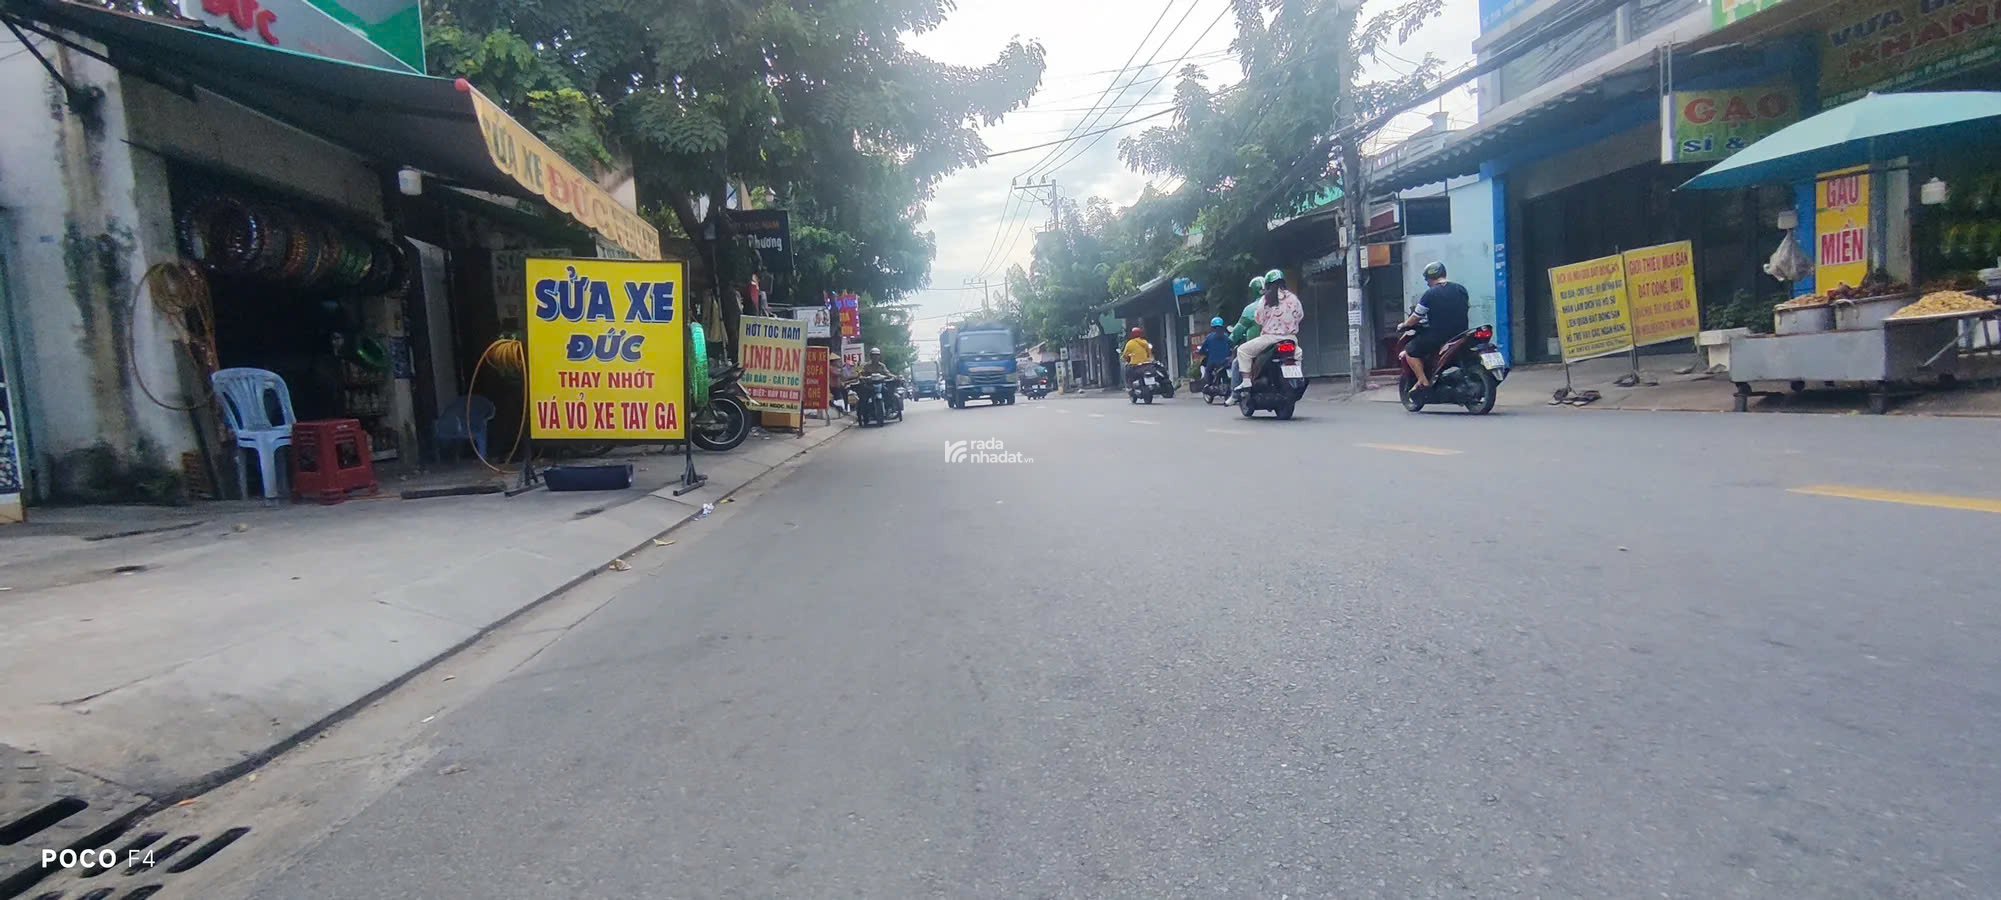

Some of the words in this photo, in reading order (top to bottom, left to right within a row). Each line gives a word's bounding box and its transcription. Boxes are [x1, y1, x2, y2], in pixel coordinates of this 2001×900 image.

[535, 265, 615, 323] SỬA
[624, 281, 674, 323] XE
[567, 327, 645, 361] ĐỨC
[782, 326, 800, 340] NAM
[743, 344, 772, 369] LINH
[774, 347, 801, 372] ĐAN
[558, 371, 601, 388] THAY
[608, 369, 655, 388] NHỚT
[538, 395, 560, 429] VÁ
[565, 392, 587, 430] VỎ
[594, 402, 615, 429] XE
[621, 402, 648, 429] TAY
[655, 402, 677, 430] GA
